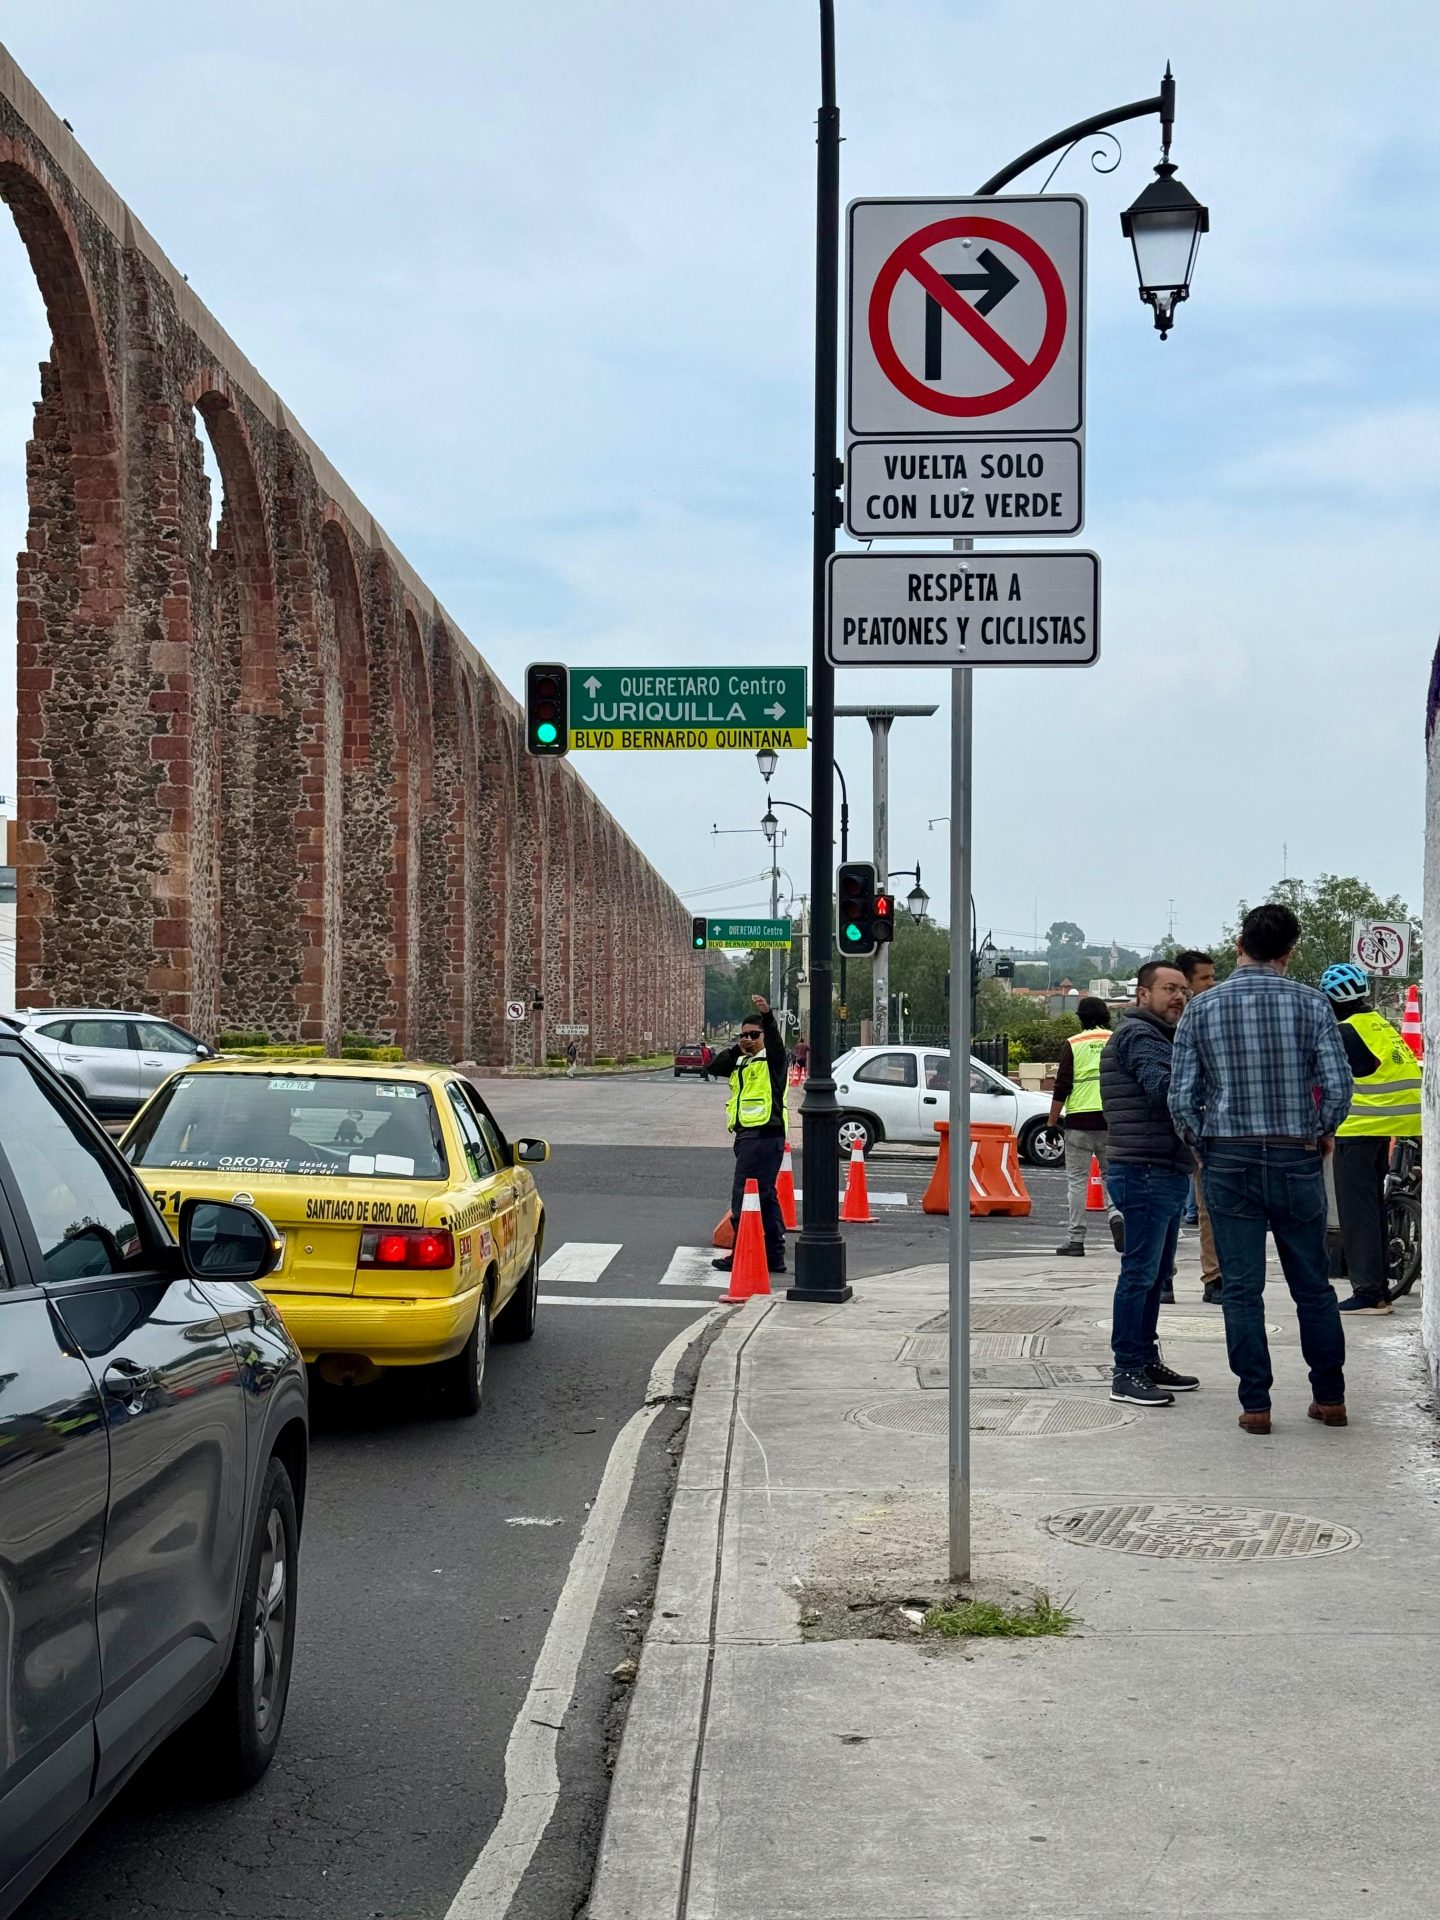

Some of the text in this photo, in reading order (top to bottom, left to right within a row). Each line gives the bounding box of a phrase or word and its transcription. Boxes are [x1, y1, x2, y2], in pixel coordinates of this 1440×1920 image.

[884, 453, 1043, 480] VUELTA SOLO
[866, 492, 1062, 519] CON LUZ VERDE
[908, 573, 1021, 601] RESPETA A
[843, 616, 1086, 645] PEATONES Y CICLISTAS
[620, 676, 786, 697] QUERETARO Centro
[582, 702, 746, 721] JURIQUILLA
[575, 730, 793, 748] BLVD BERNARDO QUINTANA
[728, 925, 783, 936] QUERETARO Centro
[219, 1156, 290, 1169] QROTaxi
[299, 1160, 327, 1168] desde
[306, 1198, 419, 1224] SANTIAGO DE QRO. QRO.
